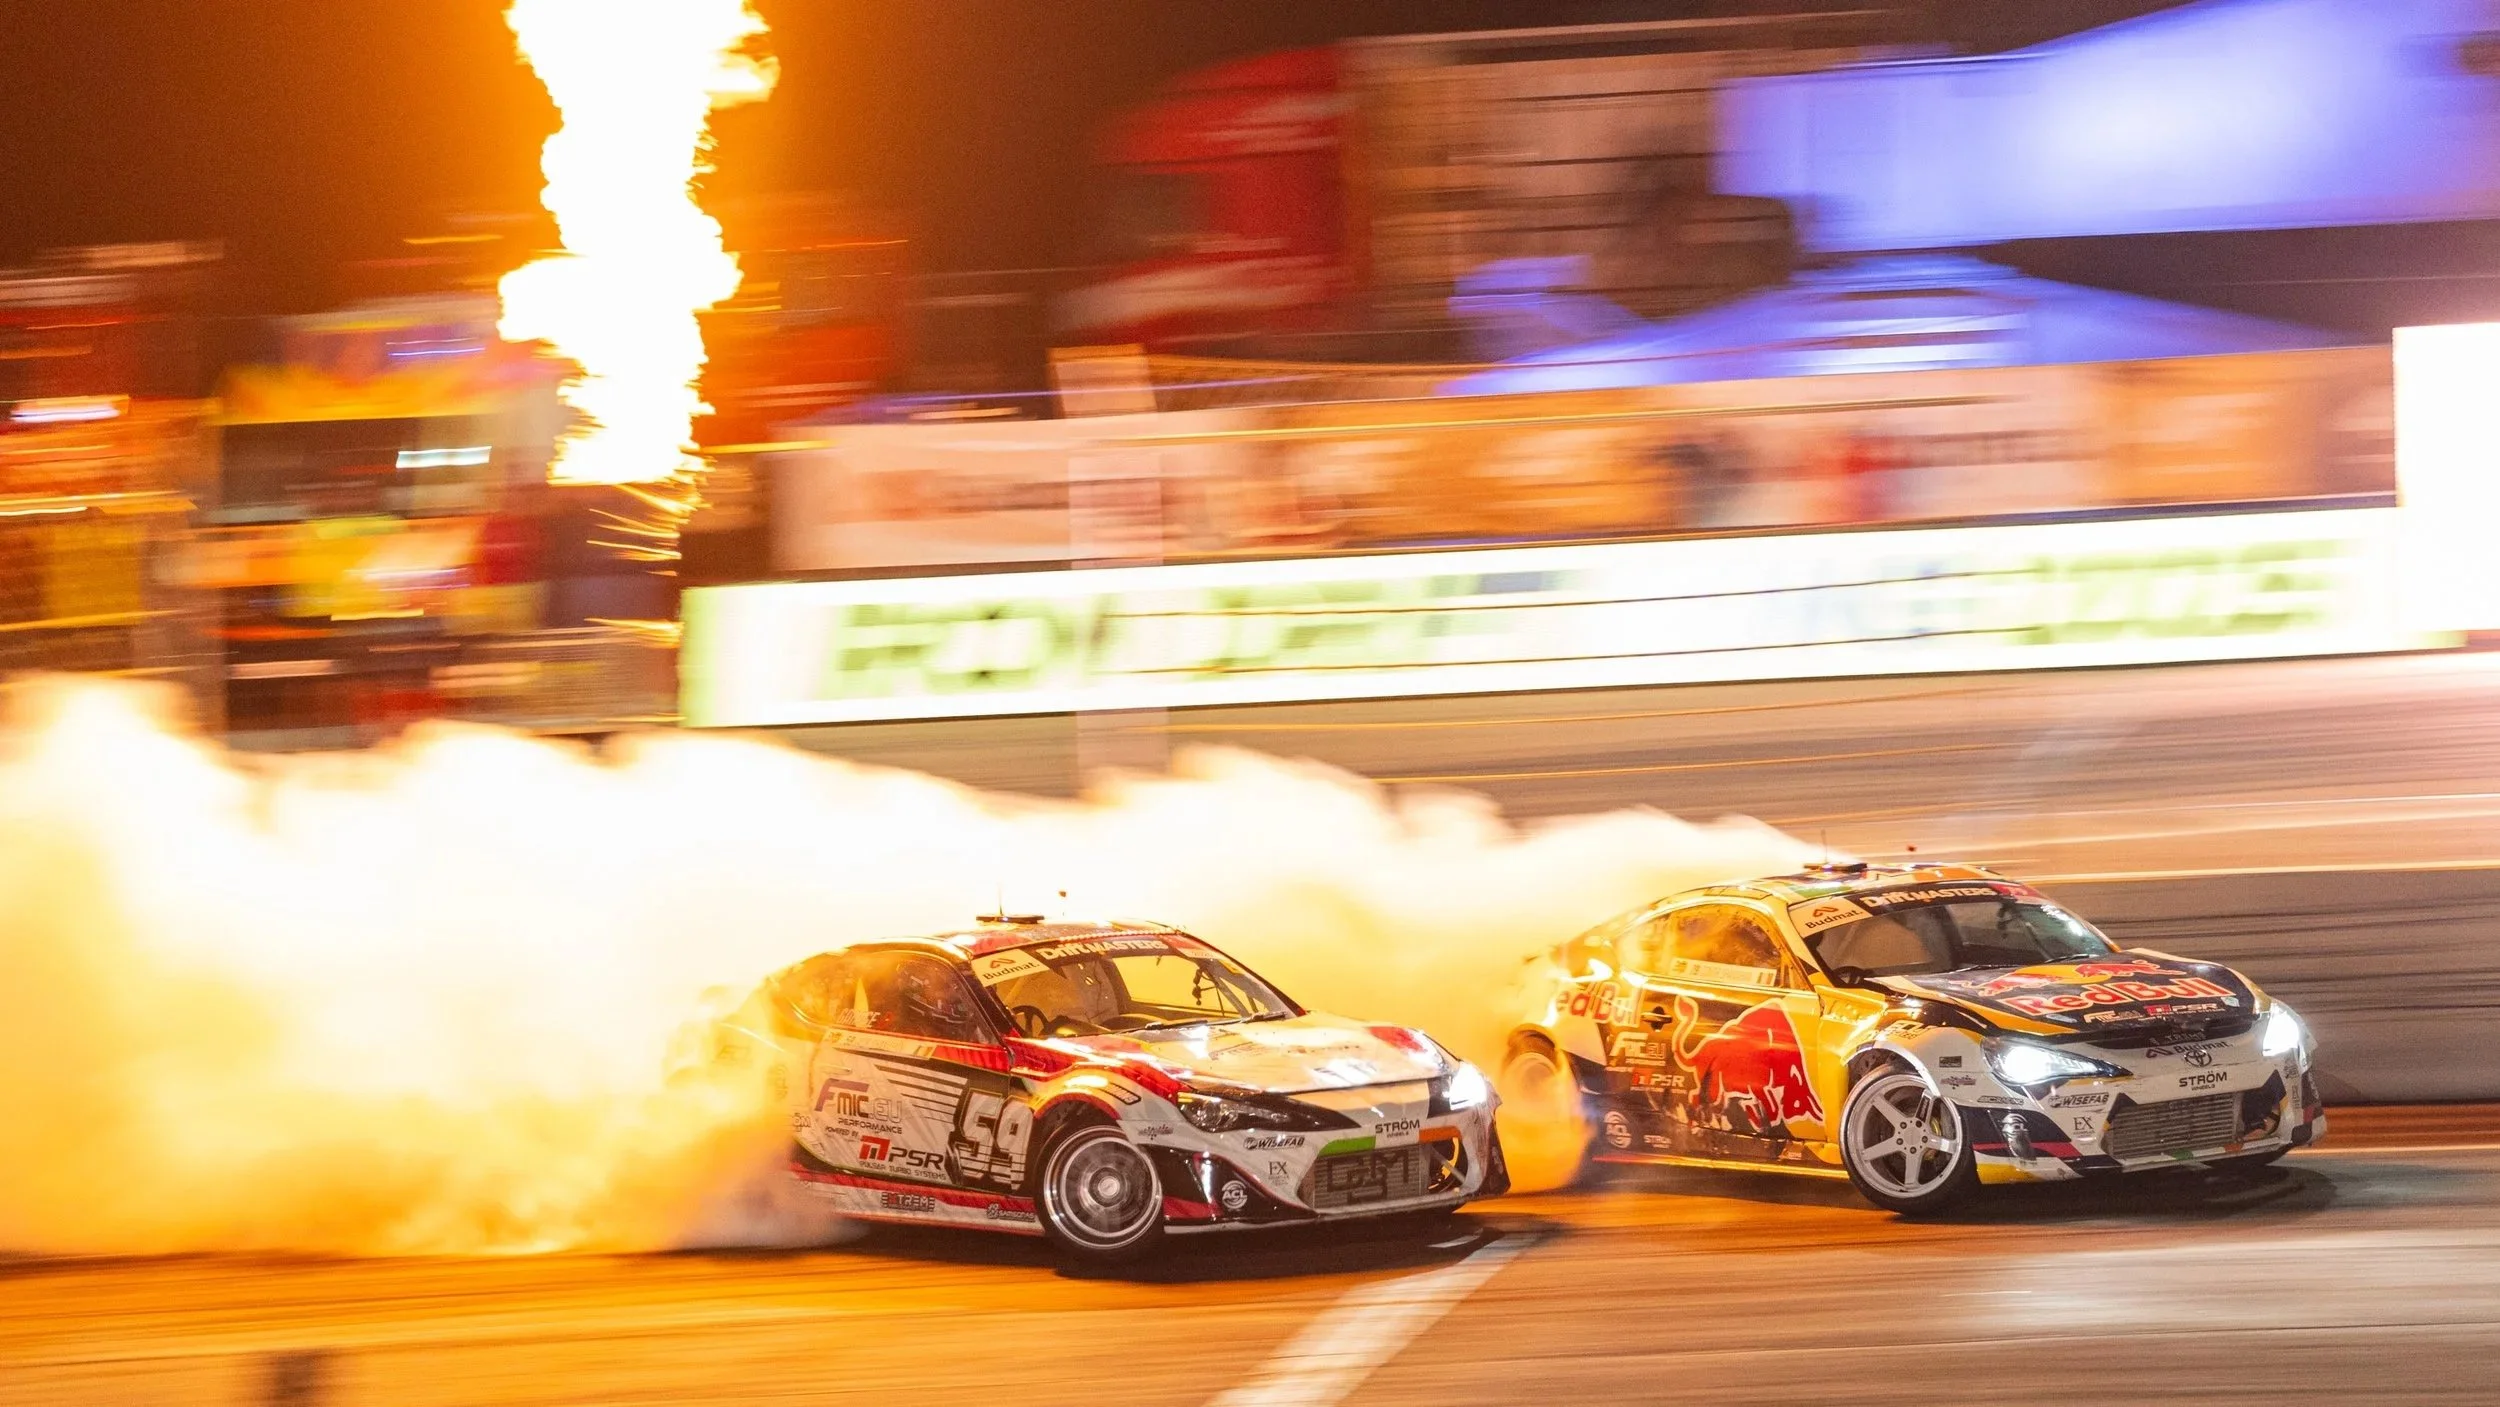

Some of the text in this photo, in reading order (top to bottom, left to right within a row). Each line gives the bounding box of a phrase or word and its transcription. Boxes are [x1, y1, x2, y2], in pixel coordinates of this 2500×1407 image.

[2179, 1071, 2228, 1088] STRÖM
[2062, 1094, 2109, 1106] WISEFAB
[838, 1117, 903, 1134] PERFORMANCE
[1375, 1118, 1421, 1134] STRÖM
[956, 1090, 1034, 1190] 59
[888, 1147, 944, 1170] PSR
[889, 1165, 912, 1176] TURBO
[914, 1170, 947, 1180] SYSTEMS
[1222, 1190, 1248, 1200] ACL
